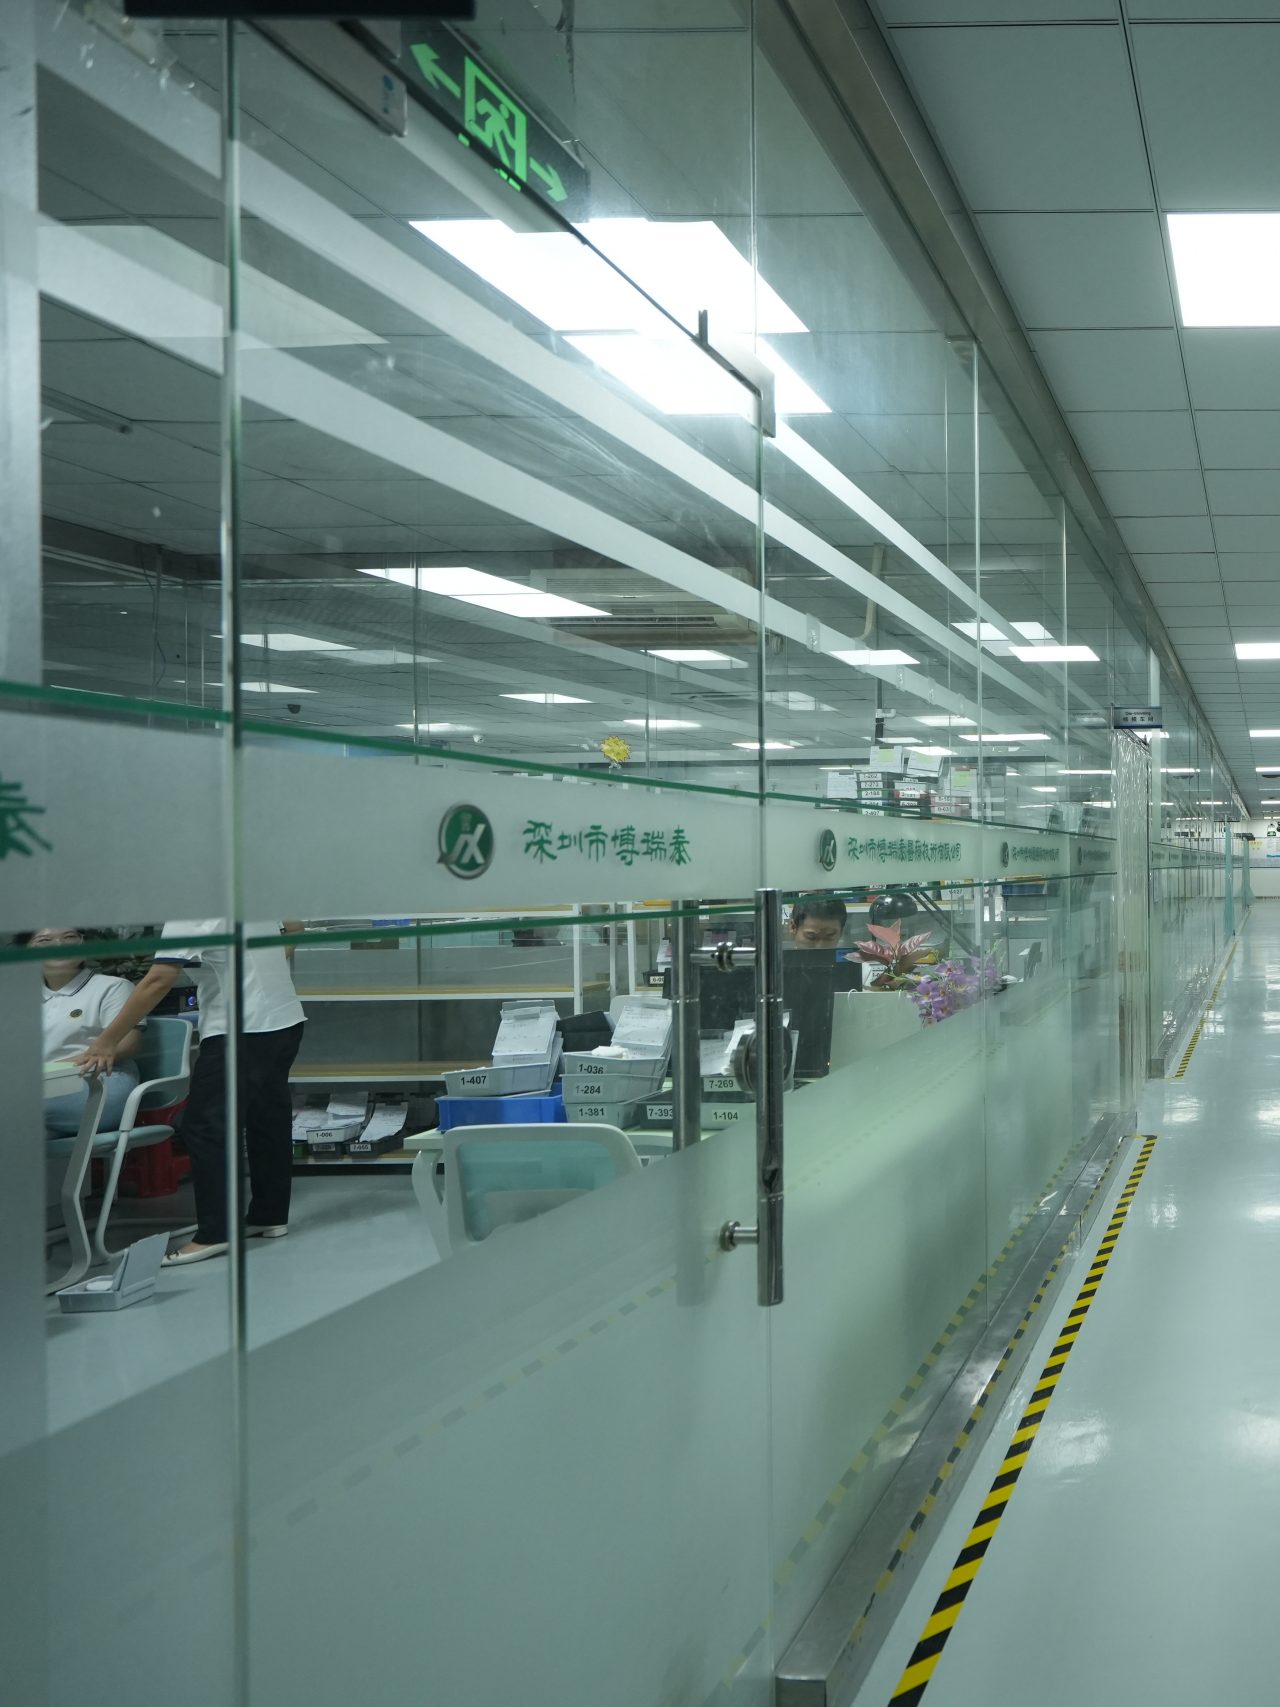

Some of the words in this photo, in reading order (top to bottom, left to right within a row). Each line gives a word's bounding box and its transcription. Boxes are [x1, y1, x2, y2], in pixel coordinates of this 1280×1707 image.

[523, 820, 692, 866] 深圳市博瑞泰
[460, 1075, 487, 1086] 1-407
[709, 1079, 734, 1089] 7-269
[713, 1111, 739, 1121] 1-104
